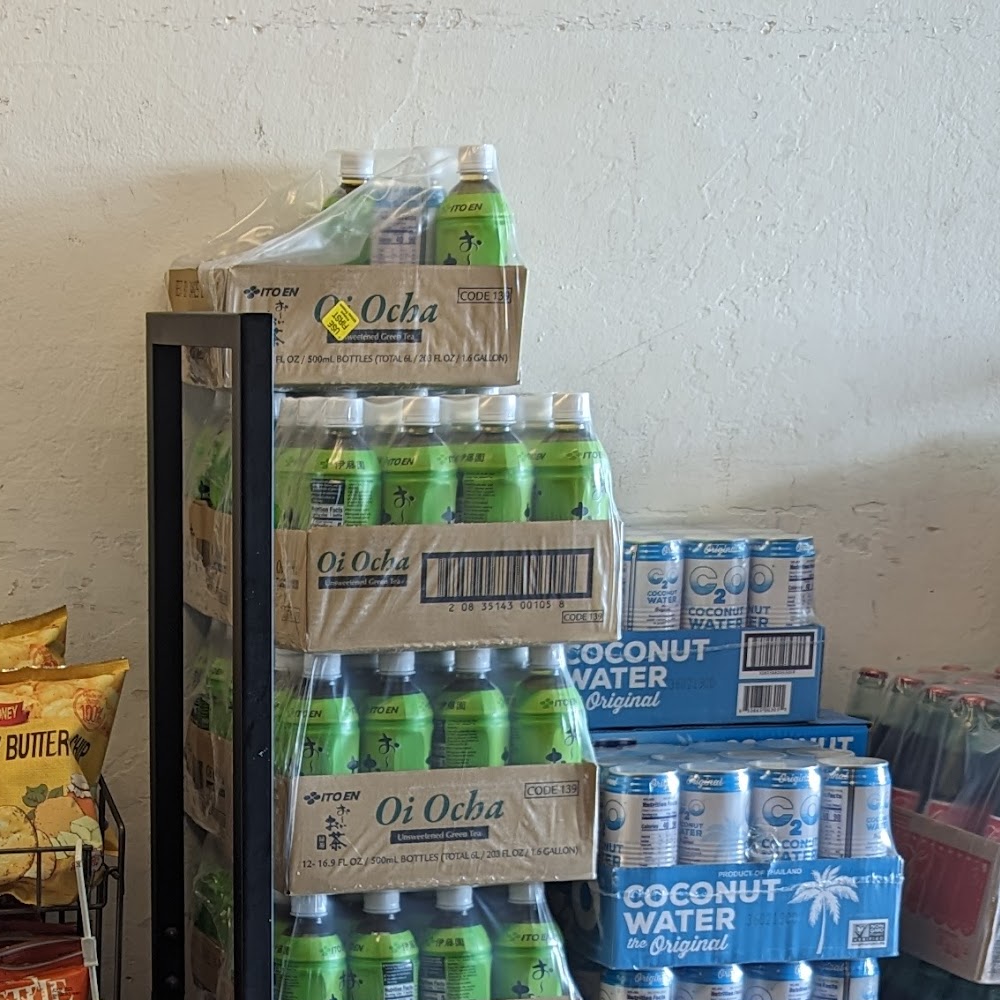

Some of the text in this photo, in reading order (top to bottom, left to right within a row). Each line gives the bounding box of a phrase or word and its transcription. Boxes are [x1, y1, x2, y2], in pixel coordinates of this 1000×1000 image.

[260, 287, 299, 297] ITO EN
[460, 291, 490, 301] CODE
[361, 292, 439, 324] Ocha
[381, 331, 415, 341] Green Tea
[287, 355, 300, 364] OZ
[337, 355, 373, 364] BOTTLES
[317, 548, 410, 574] Oi Ocha
[461, 600, 552, 612] 08 35143 00105
[563, 612, 588, 622] CODE
[586, 691, 661, 715] Original
[6, 729, 70, 761] BUTTER
[321, 790, 361, 802] ITO EN
[526, 784, 578, 796] CODE 139
[376, 789, 505, 826] Oi Ocha
[397, 830, 482, 841] Unsweetened Green Tea
[318, 858, 336, 868] 16.9
[338, 858, 349, 867] FL
[349, 857, 363, 866] OZ
[371, 856, 398, 865] 500mL
[401, 853, 439, 863] BOTTLES
[543, 846, 579, 856] GALLON)
[754, 869, 765, 877] OF
[623, 879, 782, 909] COCONUT
[623, 909, 736, 935] WATER
[626, 934, 729, 960] the Original
